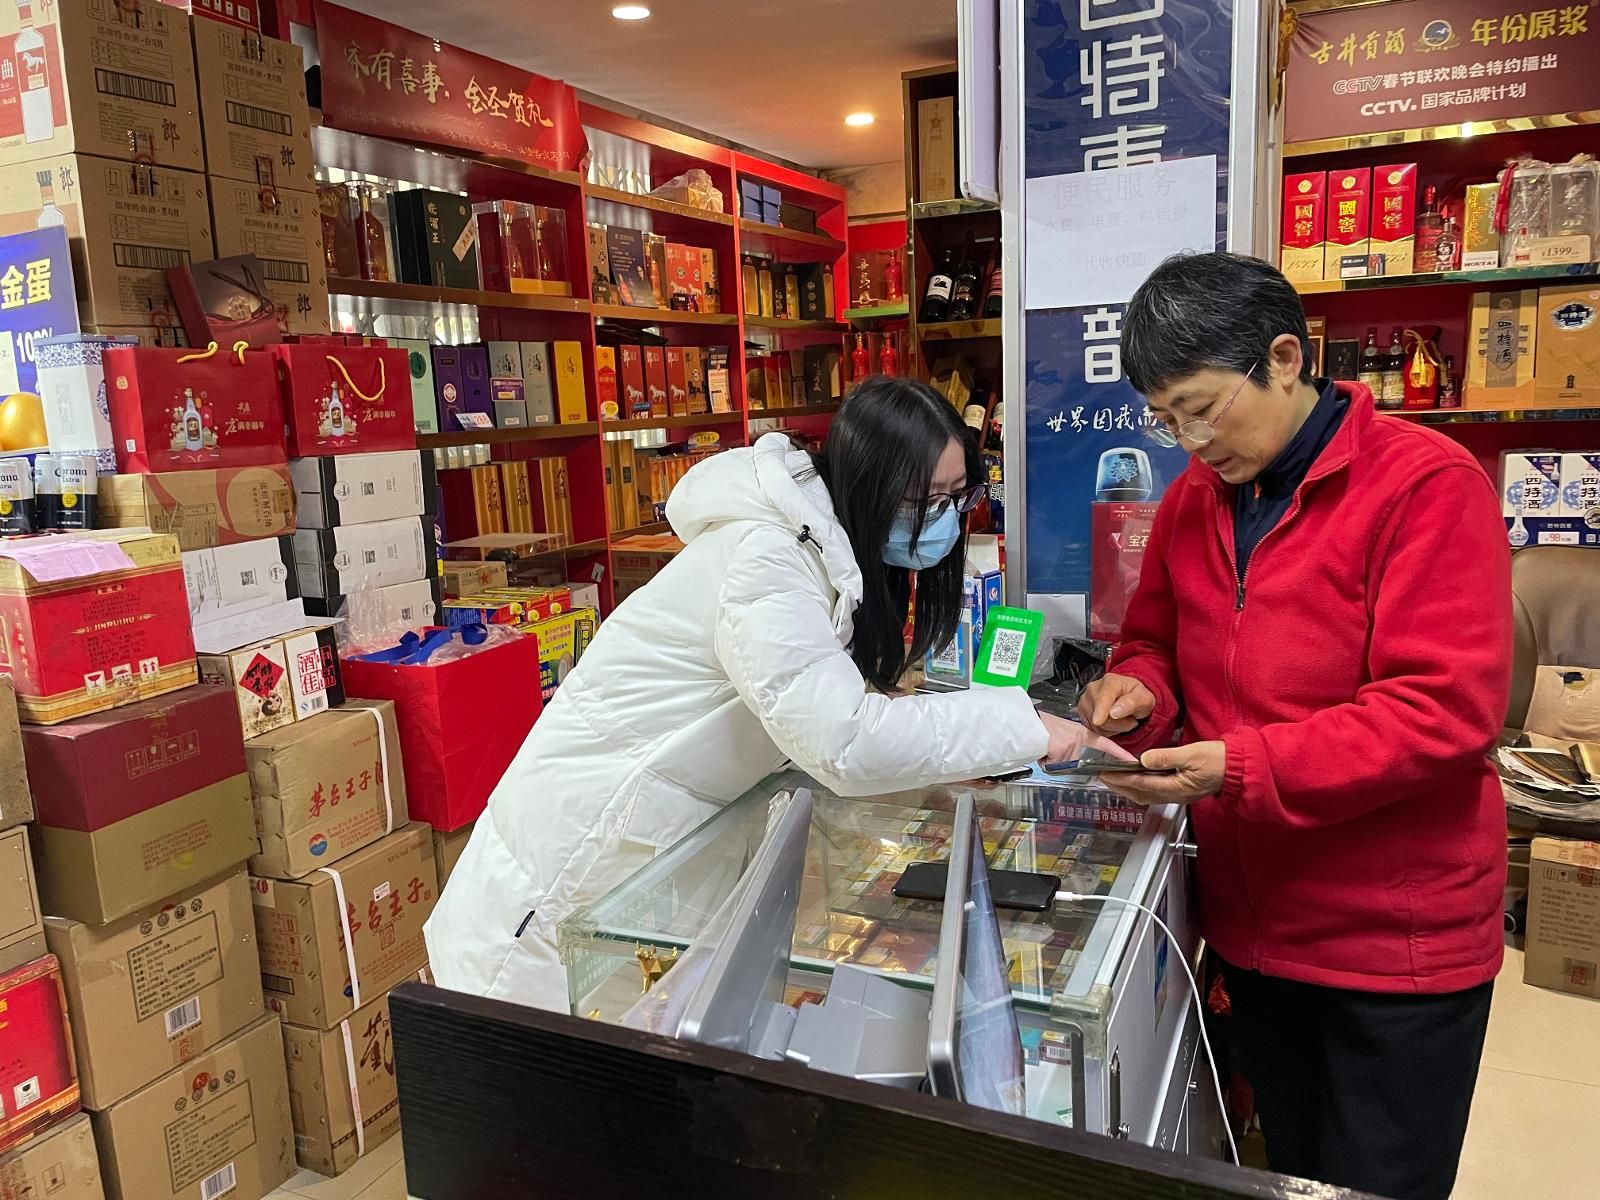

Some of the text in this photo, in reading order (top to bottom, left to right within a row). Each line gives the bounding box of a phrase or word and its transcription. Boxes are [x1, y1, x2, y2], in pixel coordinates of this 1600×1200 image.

[1471, 4, 1589, 47] 年份原浆
[1421, 82, 1527, 110] 国家品牌计划
[162, 118, 180, 153] 郎
[1052, 166, 1177, 211] 便民服务
[0, 258, 52, 310] 金蛋
[296, 292, 312, 323] 郎
[1524, 477, 1541, 509] 四特酒
[1058, 806, 1144, 824] 保健酒南昌市场终端店
